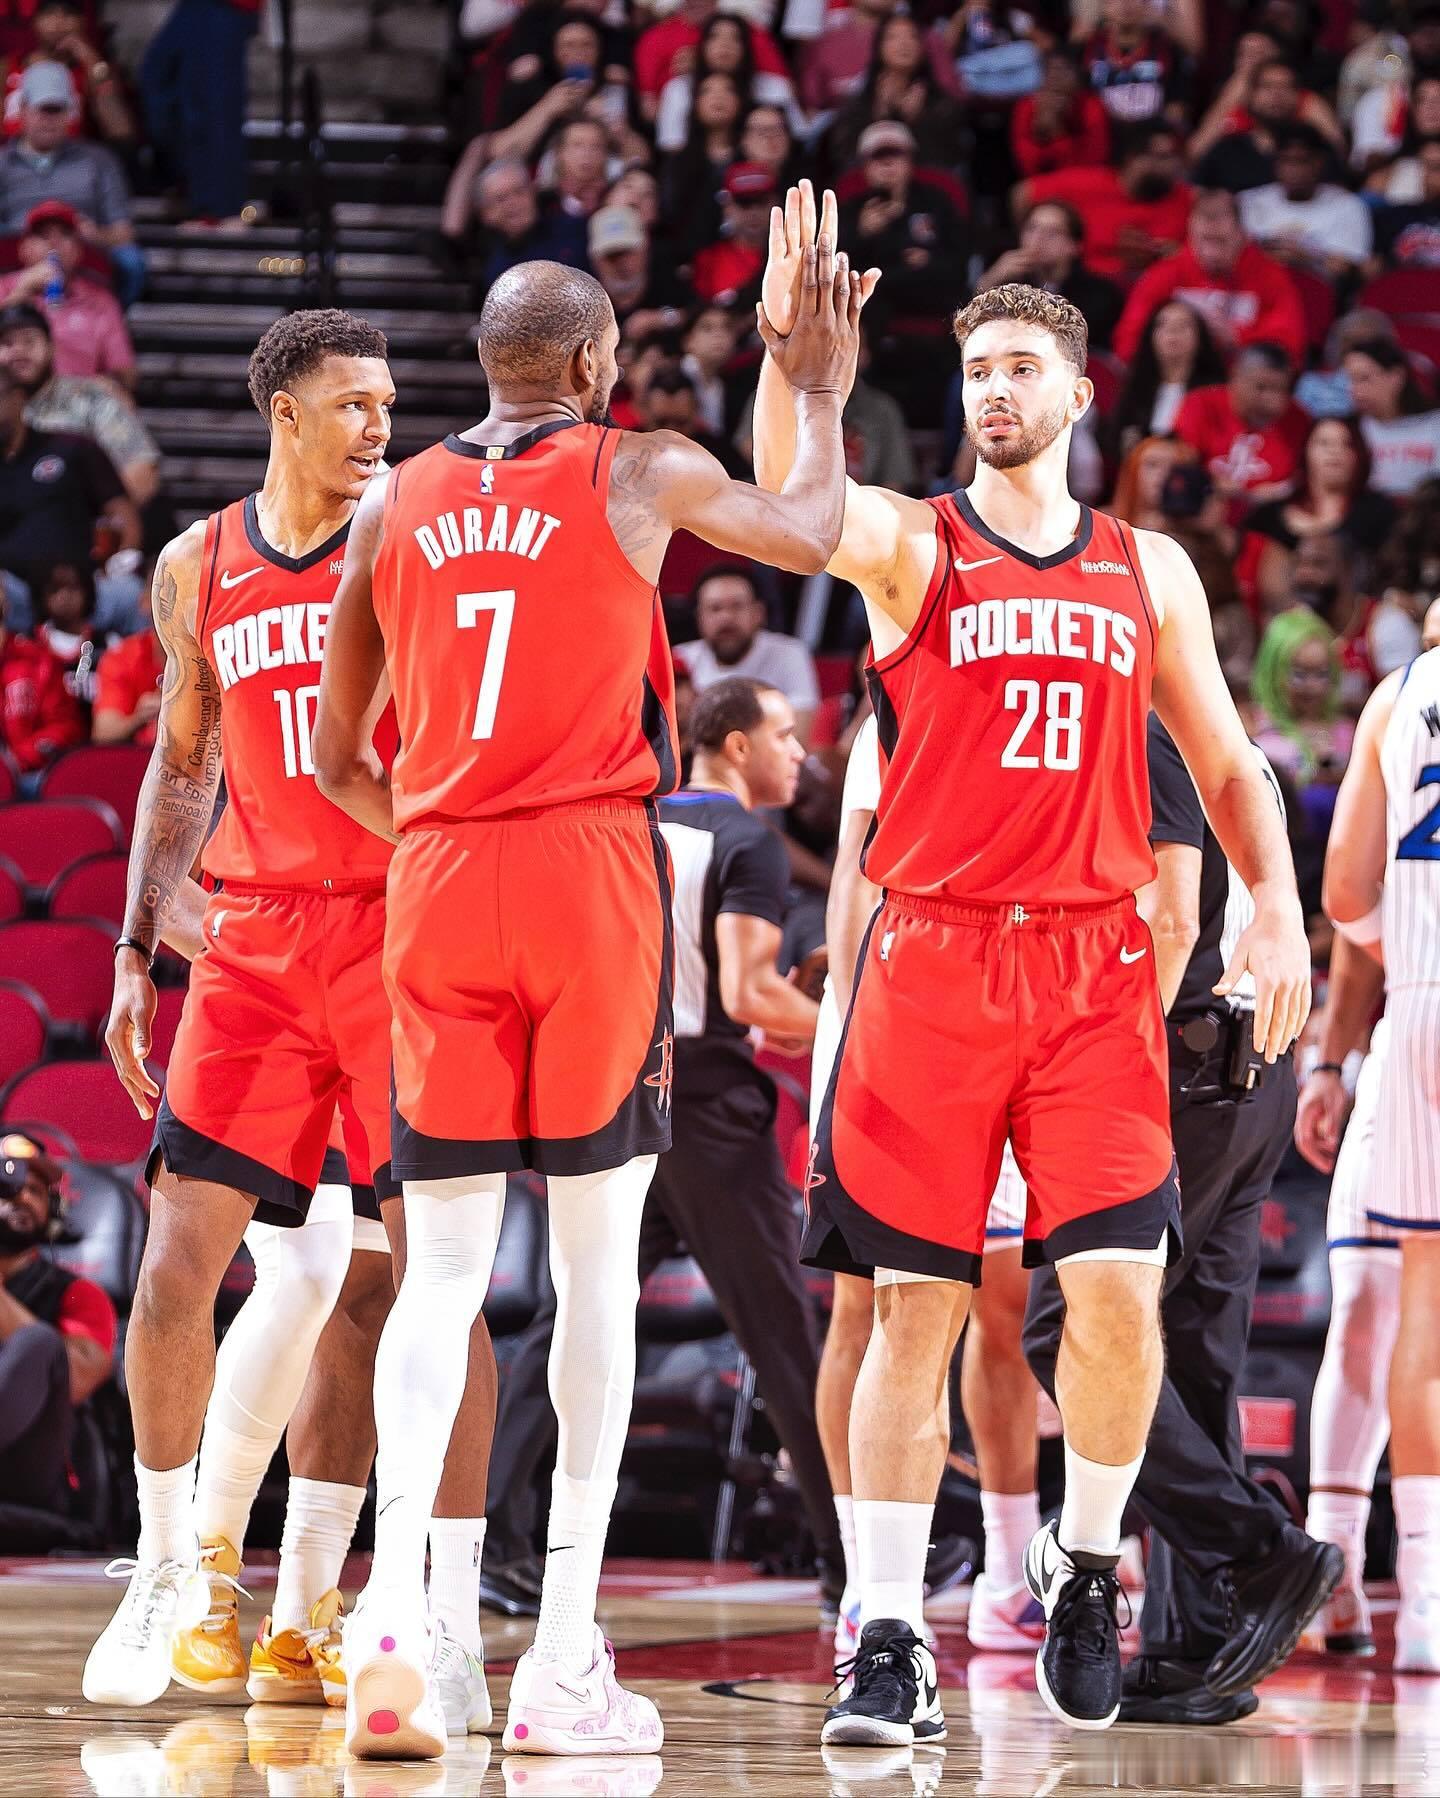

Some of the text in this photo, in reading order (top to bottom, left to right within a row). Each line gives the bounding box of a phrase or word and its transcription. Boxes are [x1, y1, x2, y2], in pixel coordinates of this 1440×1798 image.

[413, 504, 562, 571] DURANT
[456, 589, 516, 740] 7
[950, 598, 1137, 678] ROCKETS
[188, 656, 216, 767] Complacency Breeds
[1000, 679, 1084, 771] 28
